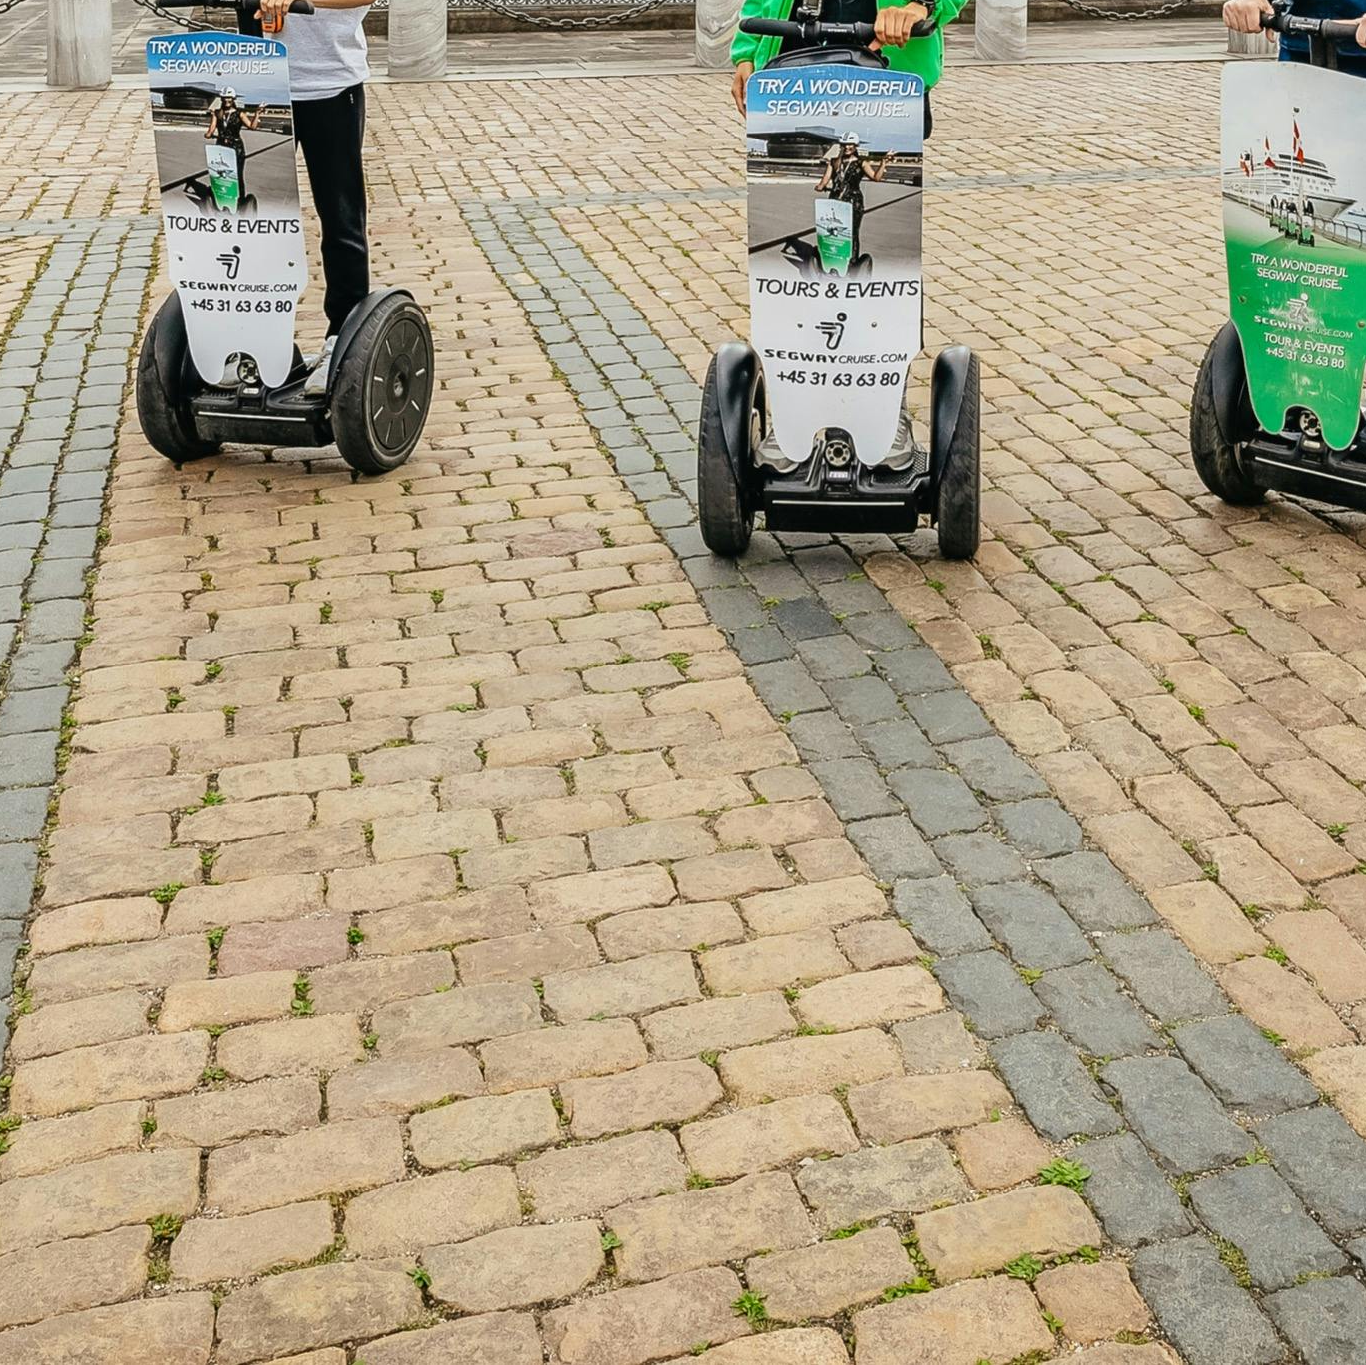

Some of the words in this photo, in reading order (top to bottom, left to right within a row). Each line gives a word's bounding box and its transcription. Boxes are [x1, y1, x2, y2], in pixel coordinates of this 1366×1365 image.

[149, 41, 176, 54] TRY
[176, 42, 188, 55] A
[191, 41, 280, 56] WONDERFUL
[159, 59, 219, 74] SEGWAY
[757, 79, 791, 95] TRY
[790, 80, 806, 95] A
[810, 80, 921, 97] WONDERFUL
[766, 99, 840, 116] SEGWAY
[167, 215, 217, 233] TOURS
[220, 218, 232, 234] &
[237, 219, 300, 234] EVENTS
[1251, 252, 1269, 265] TRY
[1270, 257, 1278, 267] A
[1280, 258, 1348, 278] WONDERFUL
[1256, 267, 1299, 284] SEGWAY
[179, 280, 298, 293] SEGWAYCRUISE.COM
[756, 278, 820, 298] TOURS
[825, 282, 839, 299] &
[845, 280, 919, 299] EVENTS
[191, 299, 214, 311] +45
[217, 300, 231, 312] 31
[235, 300, 252, 313] 63
[255, 300, 272, 313] 63
[275, 300, 293, 313] 80
[1264, 332, 1292, 347] TOUR
[1294, 338, 1302, 349] &
[1304, 340, 1345, 356] EVENTS
[764, 349, 908, 364] SEGWAYCRUISE.COM
[1265, 347, 1285, 358] +45
[1287, 350, 1297, 361] 31
[1300, 353, 1313, 364] 63
[1316, 356, 1329, 367] 63
[1331, 358, 1345, 369] 80
[777, 370, 807, 385] +45
[809, 372, 827, 386] 31
[832, 373, 852, 386] 63
[856, 372, 876, 386] 63
[880, 372, 900, 386] 80
